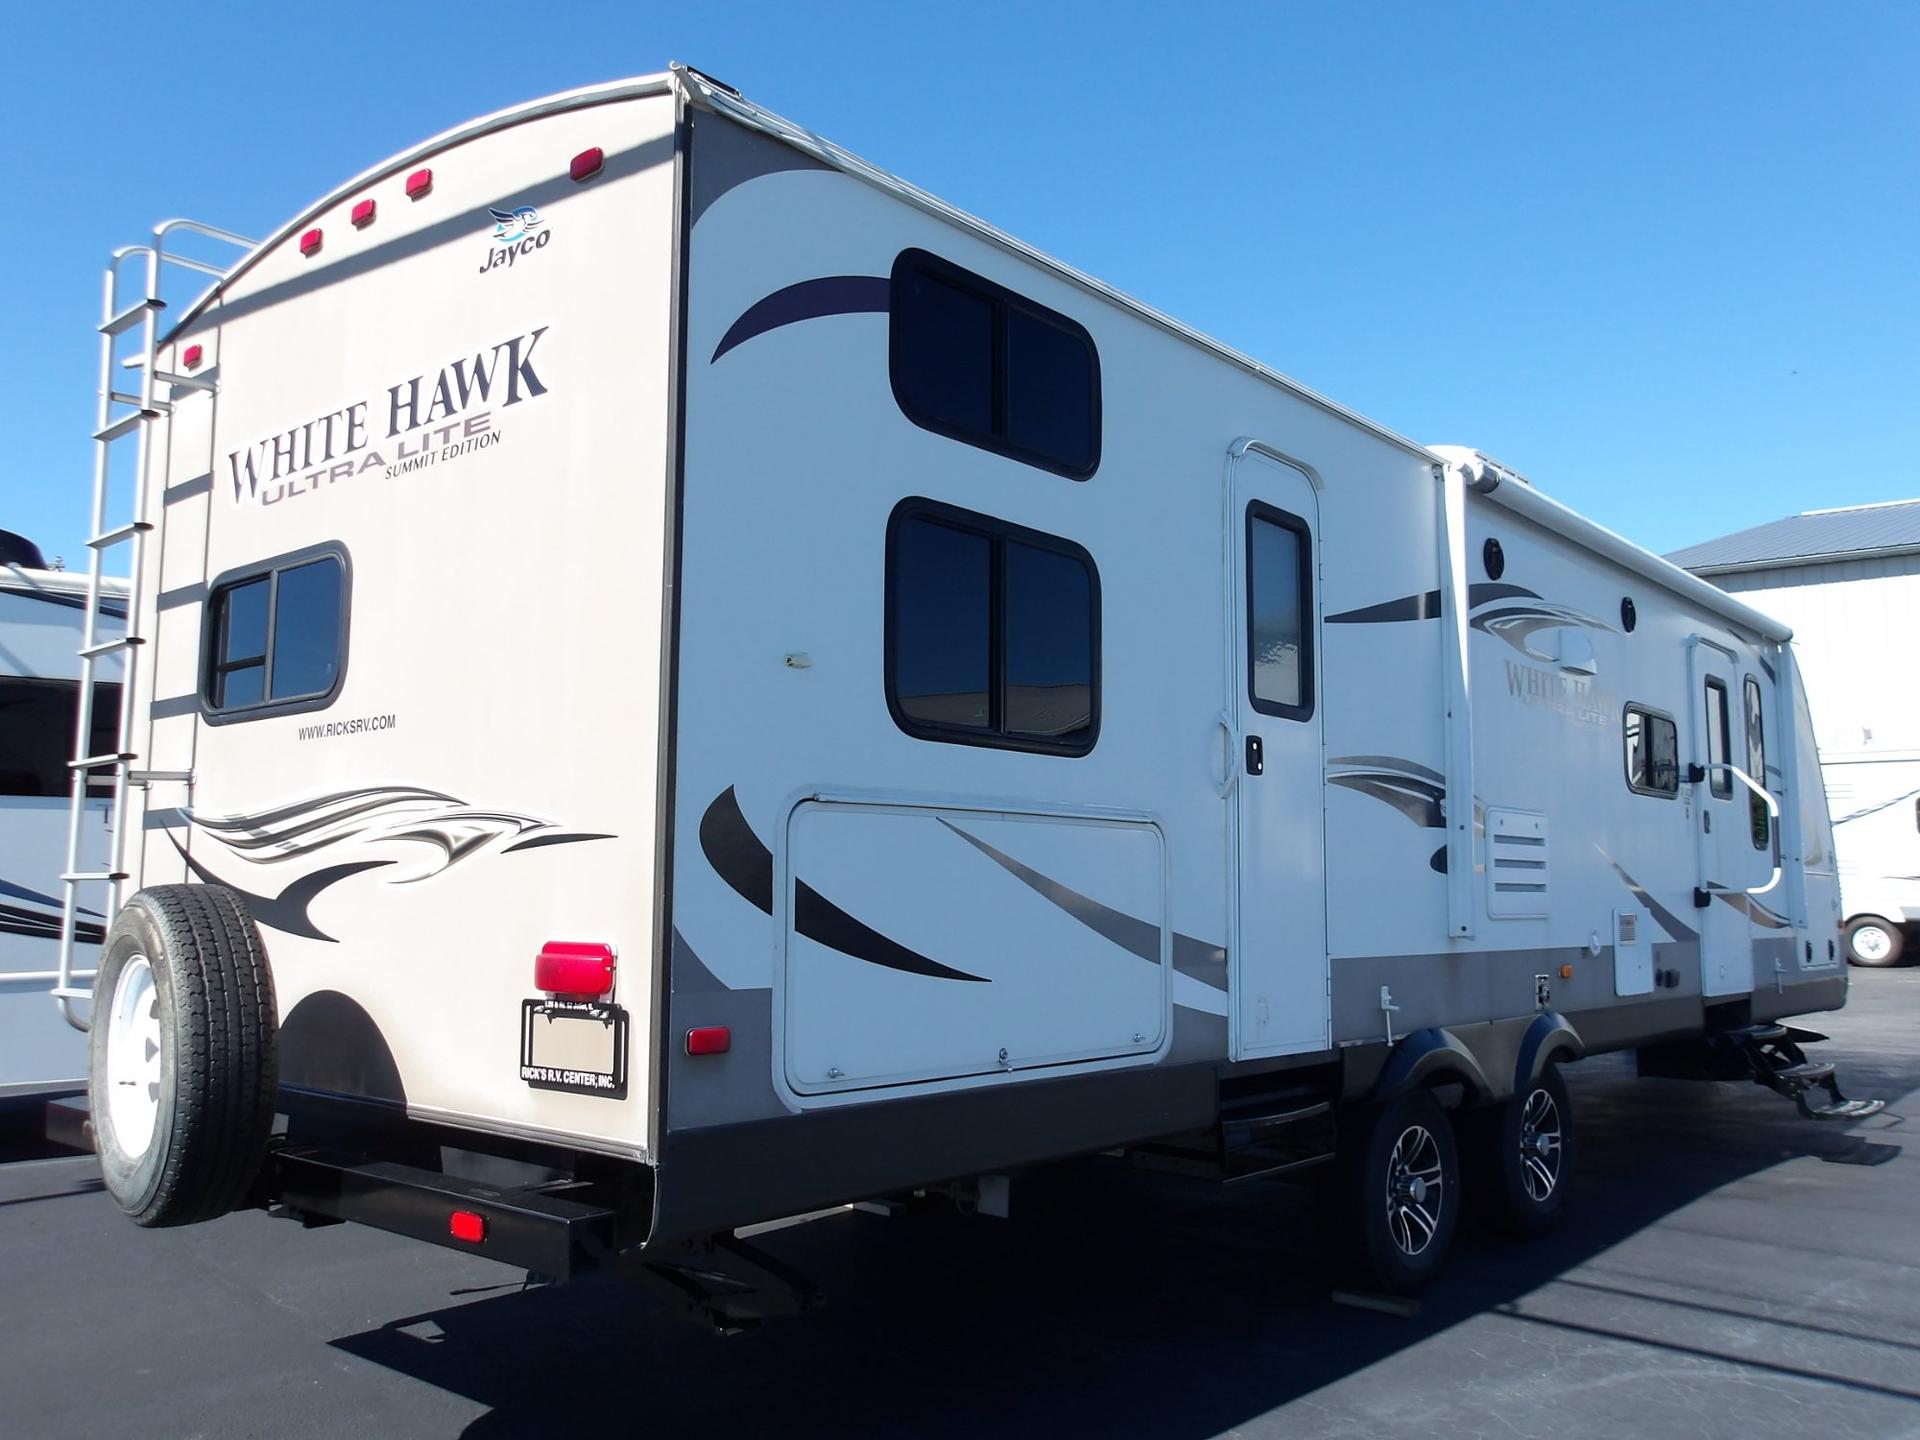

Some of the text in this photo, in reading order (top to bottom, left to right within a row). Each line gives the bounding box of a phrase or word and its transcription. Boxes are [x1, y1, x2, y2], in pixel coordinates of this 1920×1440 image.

[479, 228, 551, 274] Jayco
[228, 325, 549, 505] WHITE HAWK
[261, 411, 492, 506] ULTRA LITE
[384, 429, 502, 480] SUMMIT EDITION
[298, 714, 396, 741] WWW.RICKSRV.COM
[521, 1066, 547, 1081] RICK'S
[548, 1069, 562, 1082] R.V.
[598, 1074, 615, 1089] INC.
